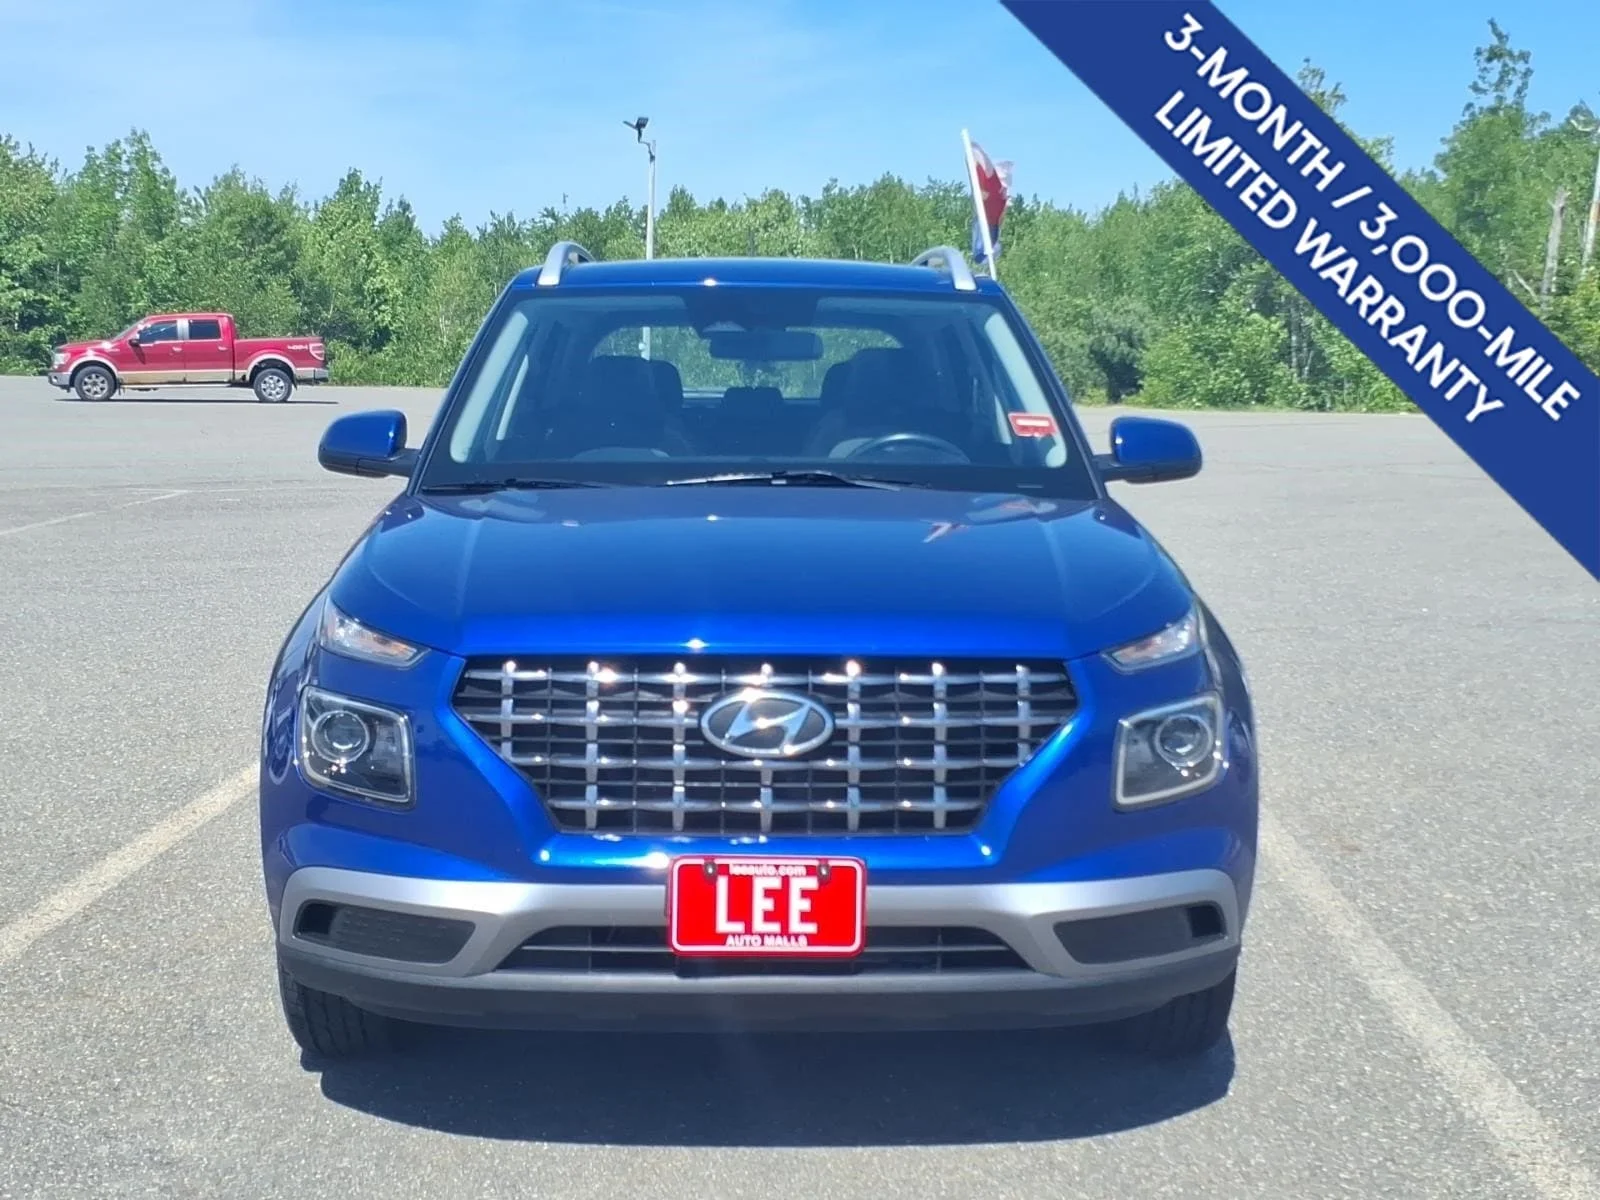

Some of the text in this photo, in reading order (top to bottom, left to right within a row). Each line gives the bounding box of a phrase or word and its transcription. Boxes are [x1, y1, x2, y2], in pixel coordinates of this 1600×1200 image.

[716, 875, 819, 934] LEE
[726, 935, 808, 948] AUTO MALLS
